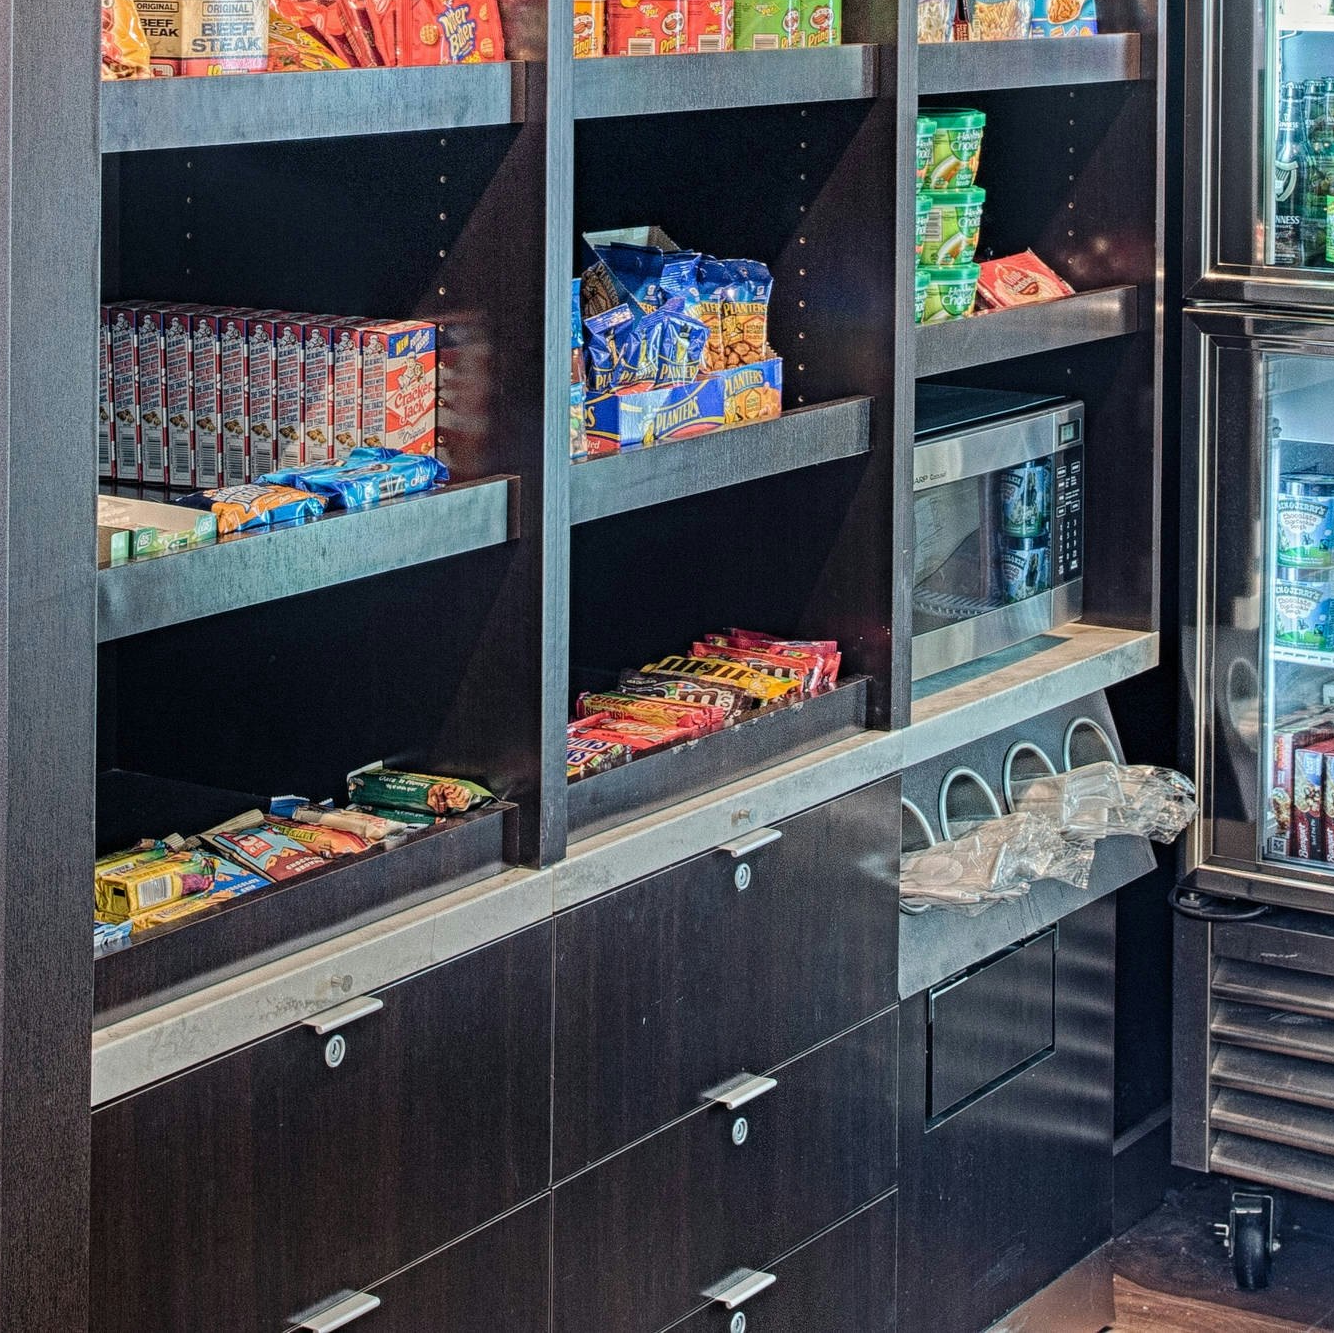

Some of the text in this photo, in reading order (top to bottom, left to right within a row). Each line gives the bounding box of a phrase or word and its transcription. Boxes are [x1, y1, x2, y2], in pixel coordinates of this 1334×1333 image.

[136, 2, 176, 12] ORIGINAL
[207, 2, 249, 14] ORIGINAL
[144, 27, 180, 38] TEAK
[201, 22, 255, 36] BEEF
[191, 37, 262, 54] STEAK
[724, 302, 768, 317] PLANTERS
[725, 369, 764, 398] PLANTERS
[394, 380, 434, 408] Cracker
[398, 400, 426, 426] Jack
[655, 396, 701, 435] PLANTERS
